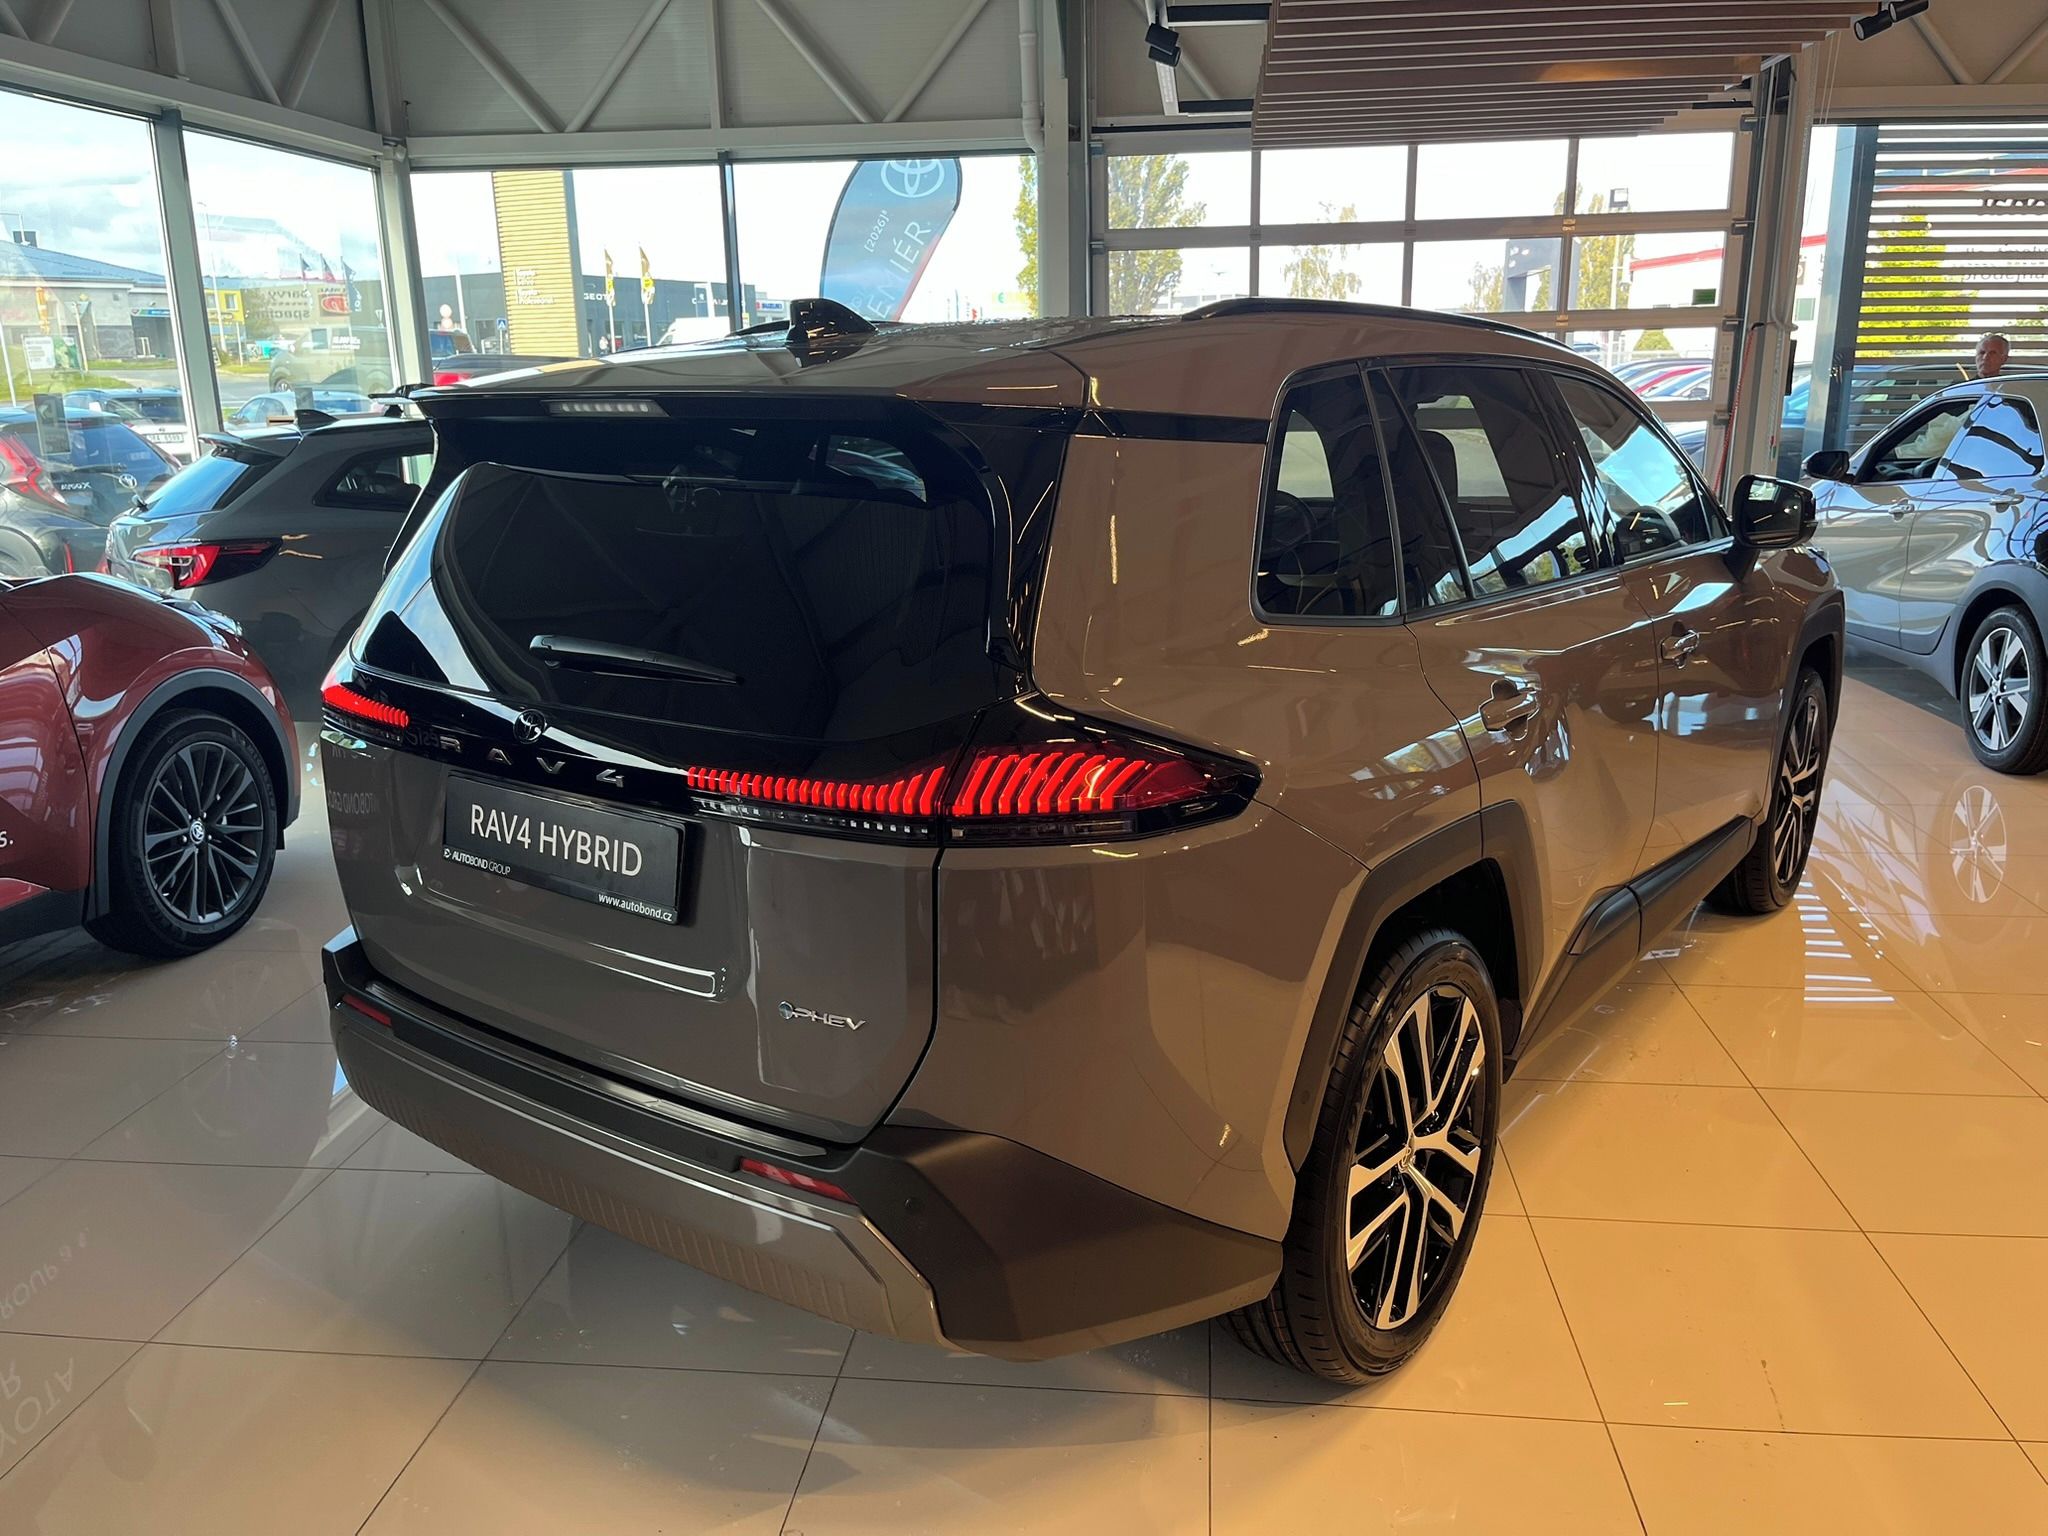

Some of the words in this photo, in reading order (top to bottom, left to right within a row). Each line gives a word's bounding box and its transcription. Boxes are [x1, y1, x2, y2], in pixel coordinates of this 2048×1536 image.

[470, 803, 532, 850] RAV4
[539, 821, 643, 877] HYBRID
[451, 852, 488, 870] AUTOBOND
[488, 862, 511, 876] GROUP
[598, 893, 673, 922] www.autobond.cz
